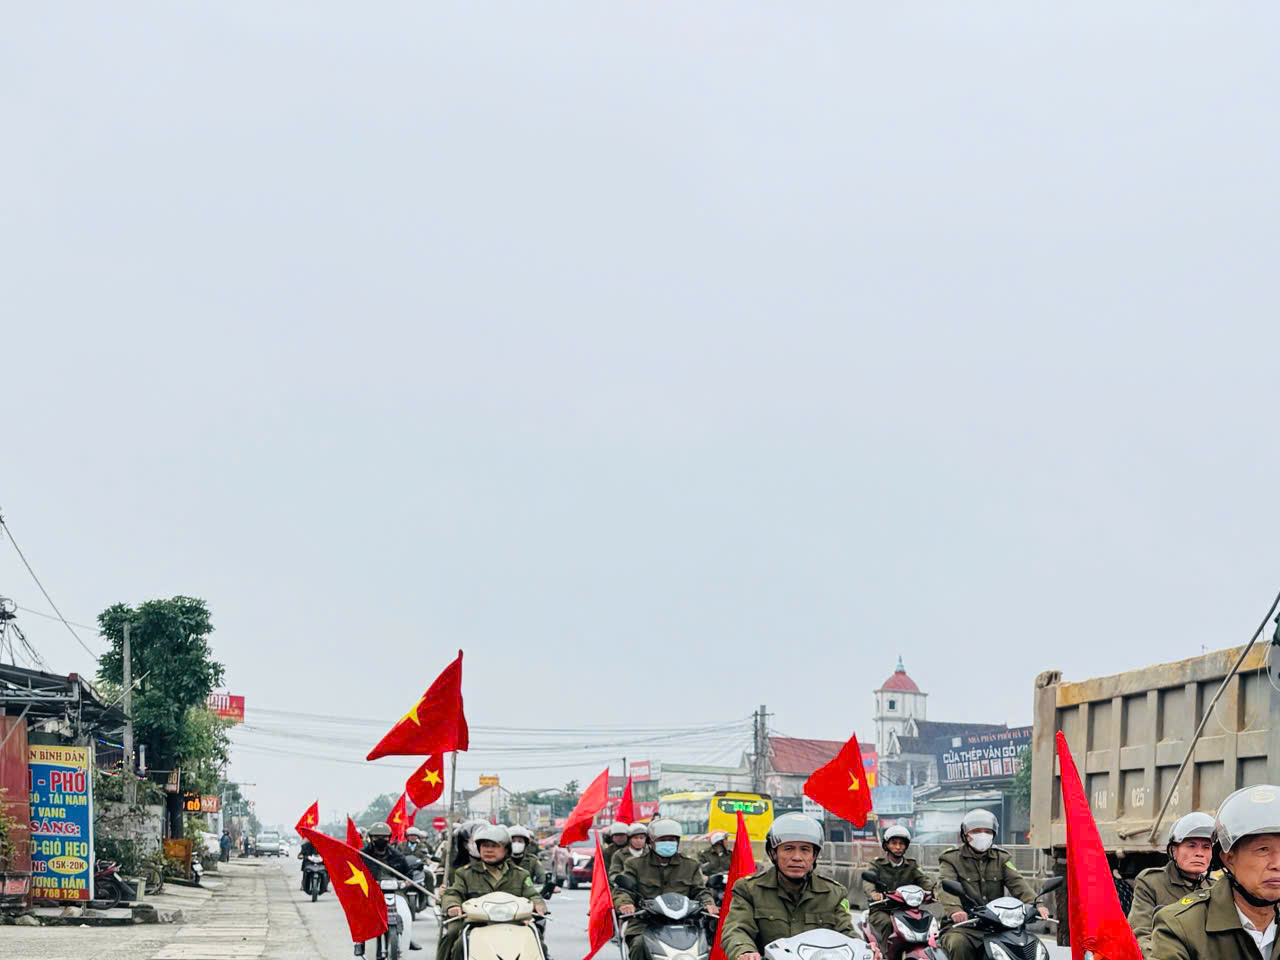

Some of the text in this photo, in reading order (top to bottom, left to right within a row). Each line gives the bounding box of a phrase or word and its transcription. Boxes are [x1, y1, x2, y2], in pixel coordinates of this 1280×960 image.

[40, 749, 61, 761] BÌNH
[64, 750, 85, 762] DÂN
[960, 746, 982, 762] THÉP
[983, 744, 1001, 760] VÂN
[50, 765, 86, 793] PHỞ
[38, 806, 66, 818] VANG
[65, 841, 88, 857] HEO
[51, 860, 85, 870] 15K-20K
